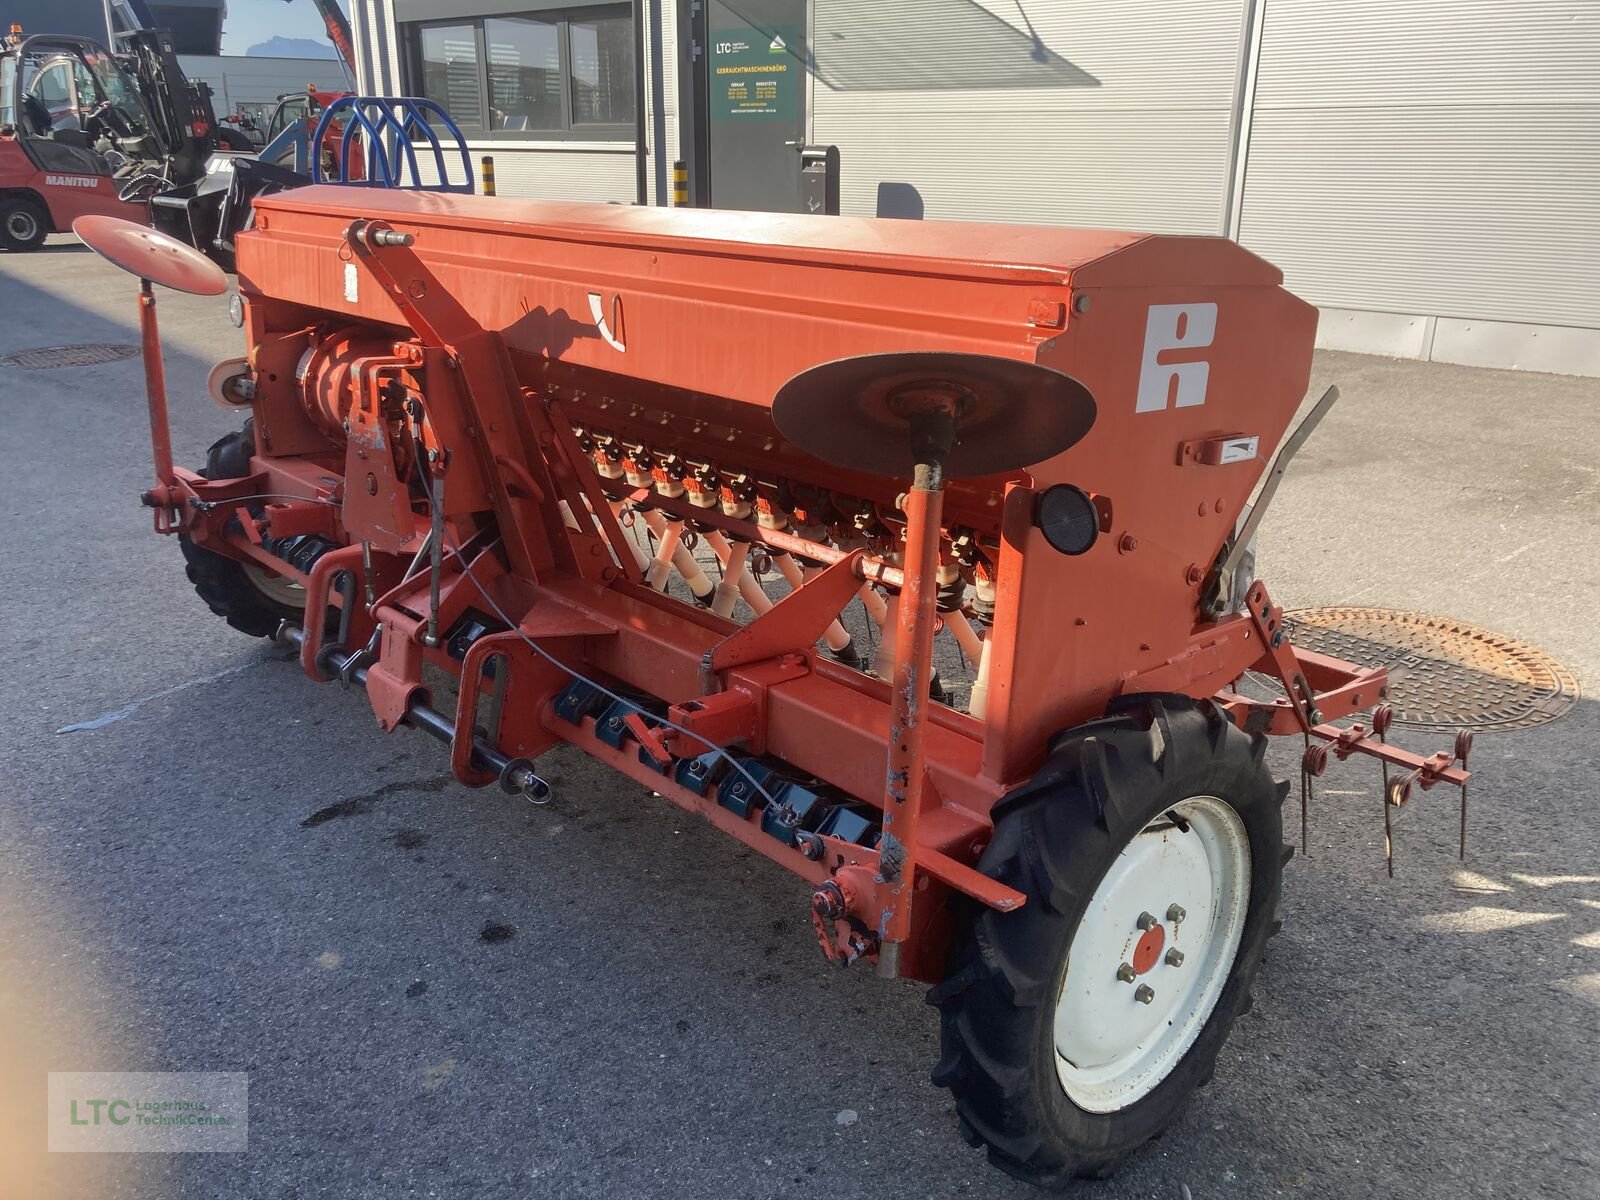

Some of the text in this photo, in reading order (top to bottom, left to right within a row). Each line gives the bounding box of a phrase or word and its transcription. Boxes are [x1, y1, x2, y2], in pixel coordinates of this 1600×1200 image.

[716, 43, 731, 54] LTC
[716, 64, 787, 75] GEBRAUCHTMASCHINENBÜRO
[45, 175, 98, 188] MANITOU
